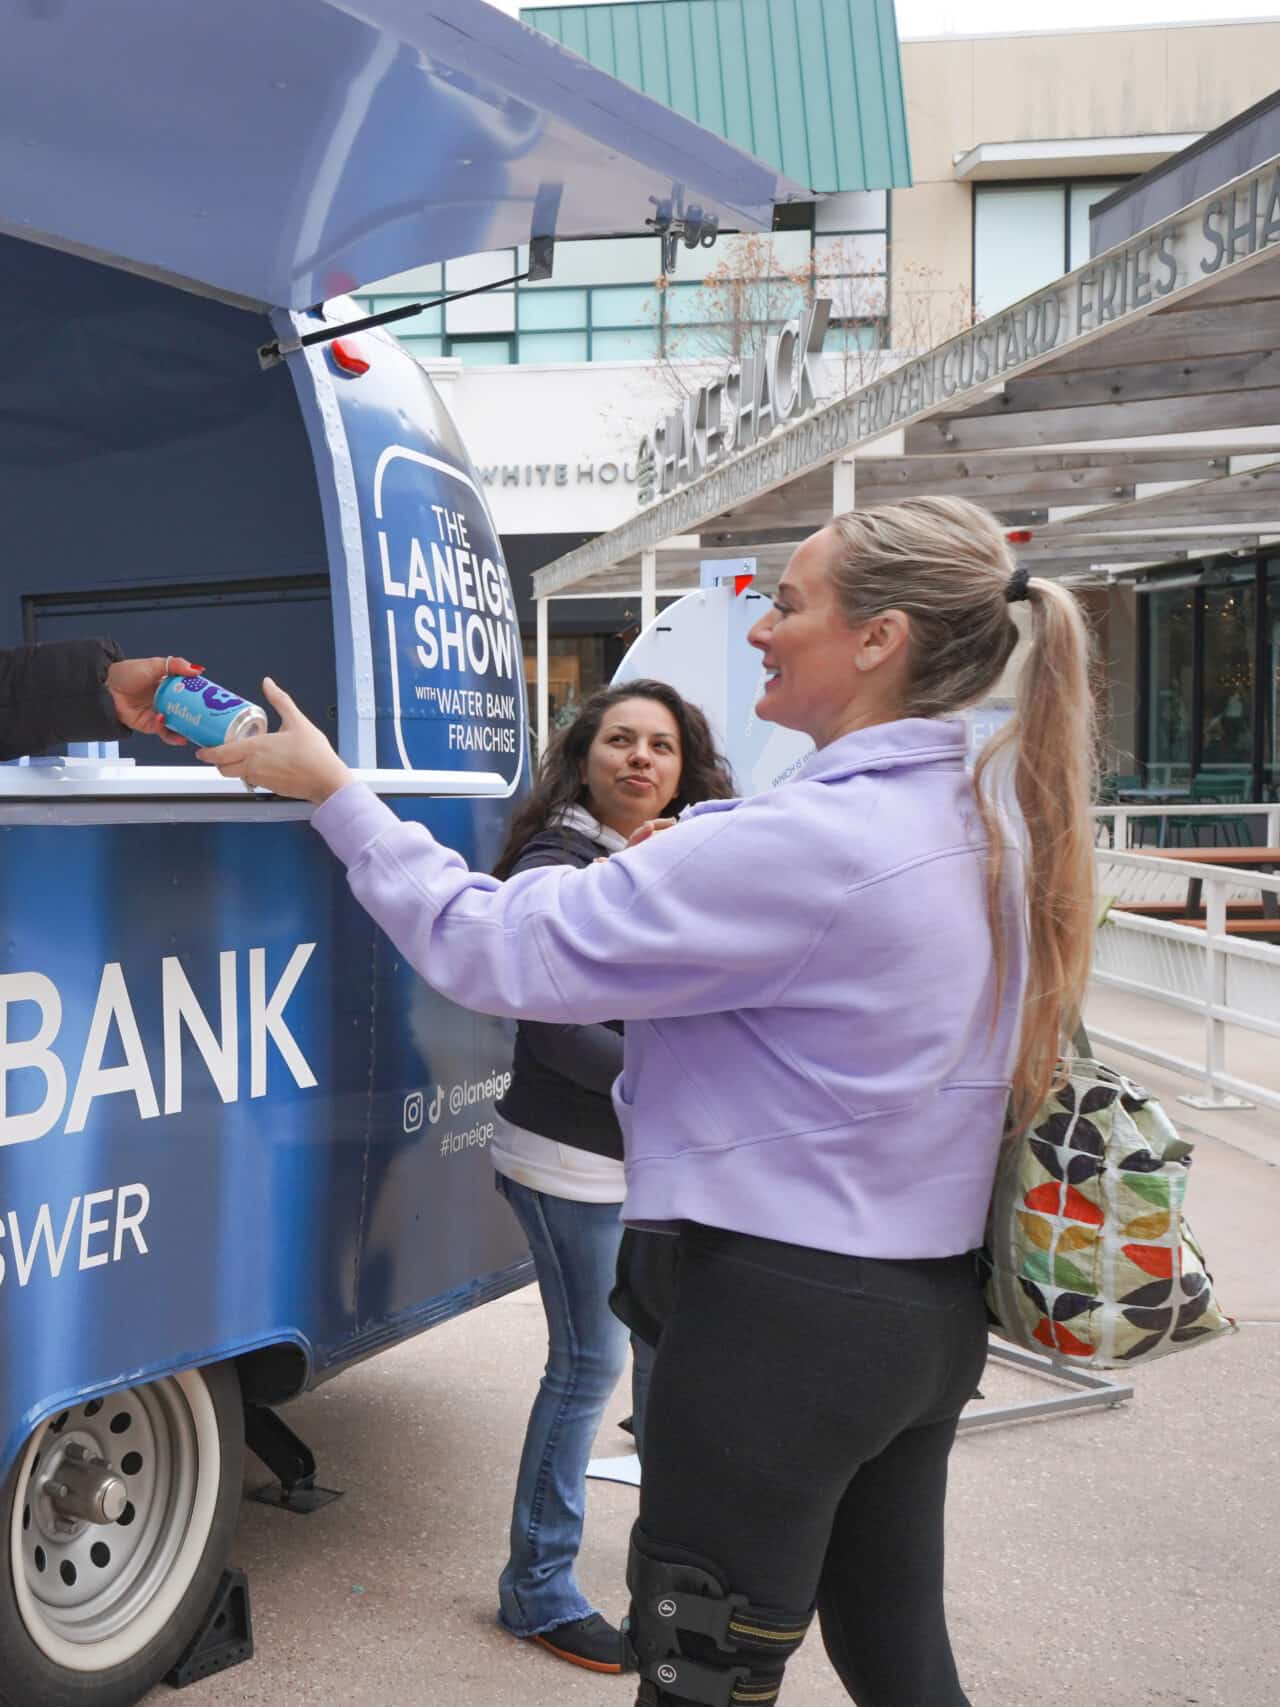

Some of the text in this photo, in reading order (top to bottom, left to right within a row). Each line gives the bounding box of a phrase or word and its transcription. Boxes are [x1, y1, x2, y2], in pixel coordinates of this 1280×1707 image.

[942, 293, 1061, 398] CUSTARD
[1077, 225, 1177, 336] FRIES
[475, 464, 568, 486] WHITE
[431, 504, 471, 549] THE
[378, 531, 514, 621] LANEIGE
[414, 605, 513, 680] SHOW
[415, 686, 516, 721] WITH WATER BANK
[448, 728, 516, 754] FRANCHISE
[448, 1068, 512, 1116] @laneige
[439, 1121, 495, 1159] #laneige
